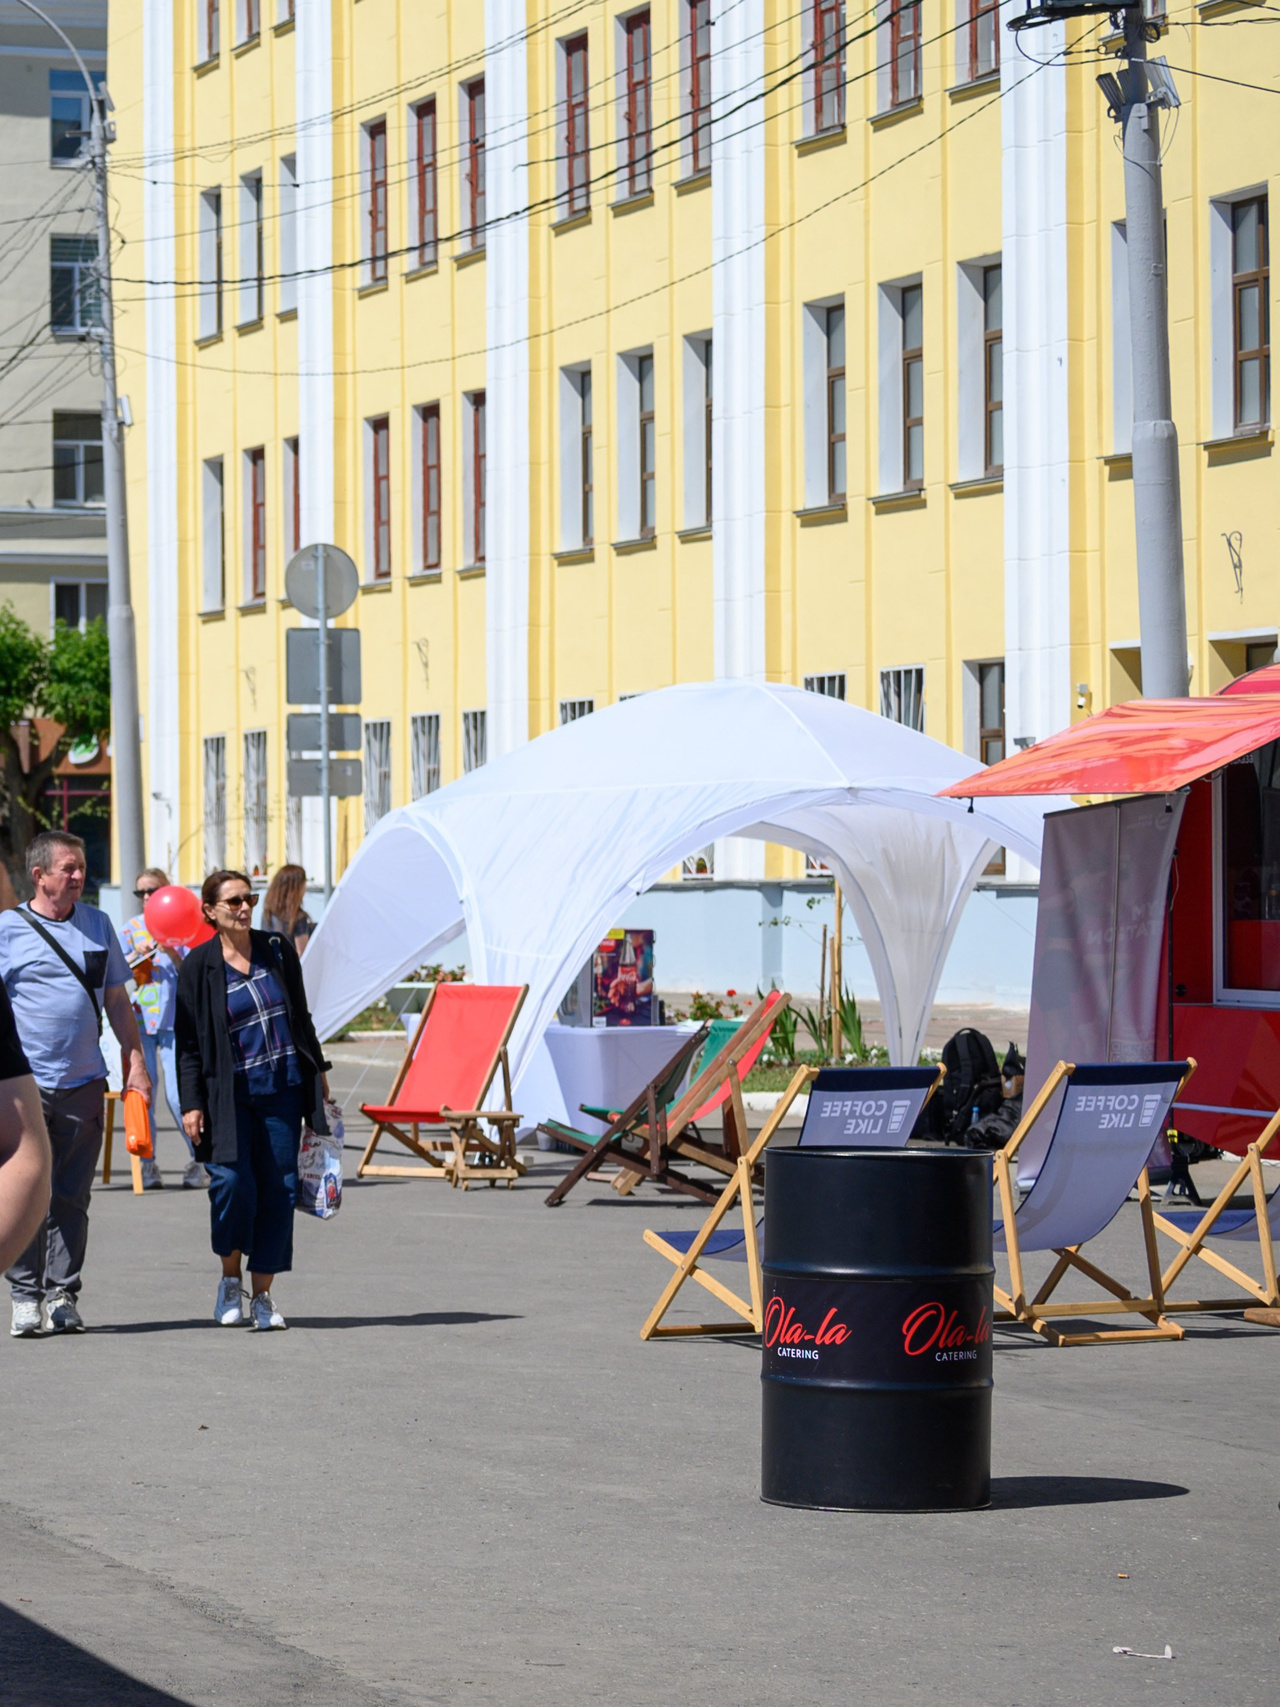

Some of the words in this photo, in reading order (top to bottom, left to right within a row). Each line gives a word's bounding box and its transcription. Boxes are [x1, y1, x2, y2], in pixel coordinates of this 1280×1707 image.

[764, 1296, 853, 1349] Ola-la
[902, 1301, 991, 1356] Ola-la
[777, 1346, 819, 1360] CATERING
[935, 1350, 978, 1362] CATERING
